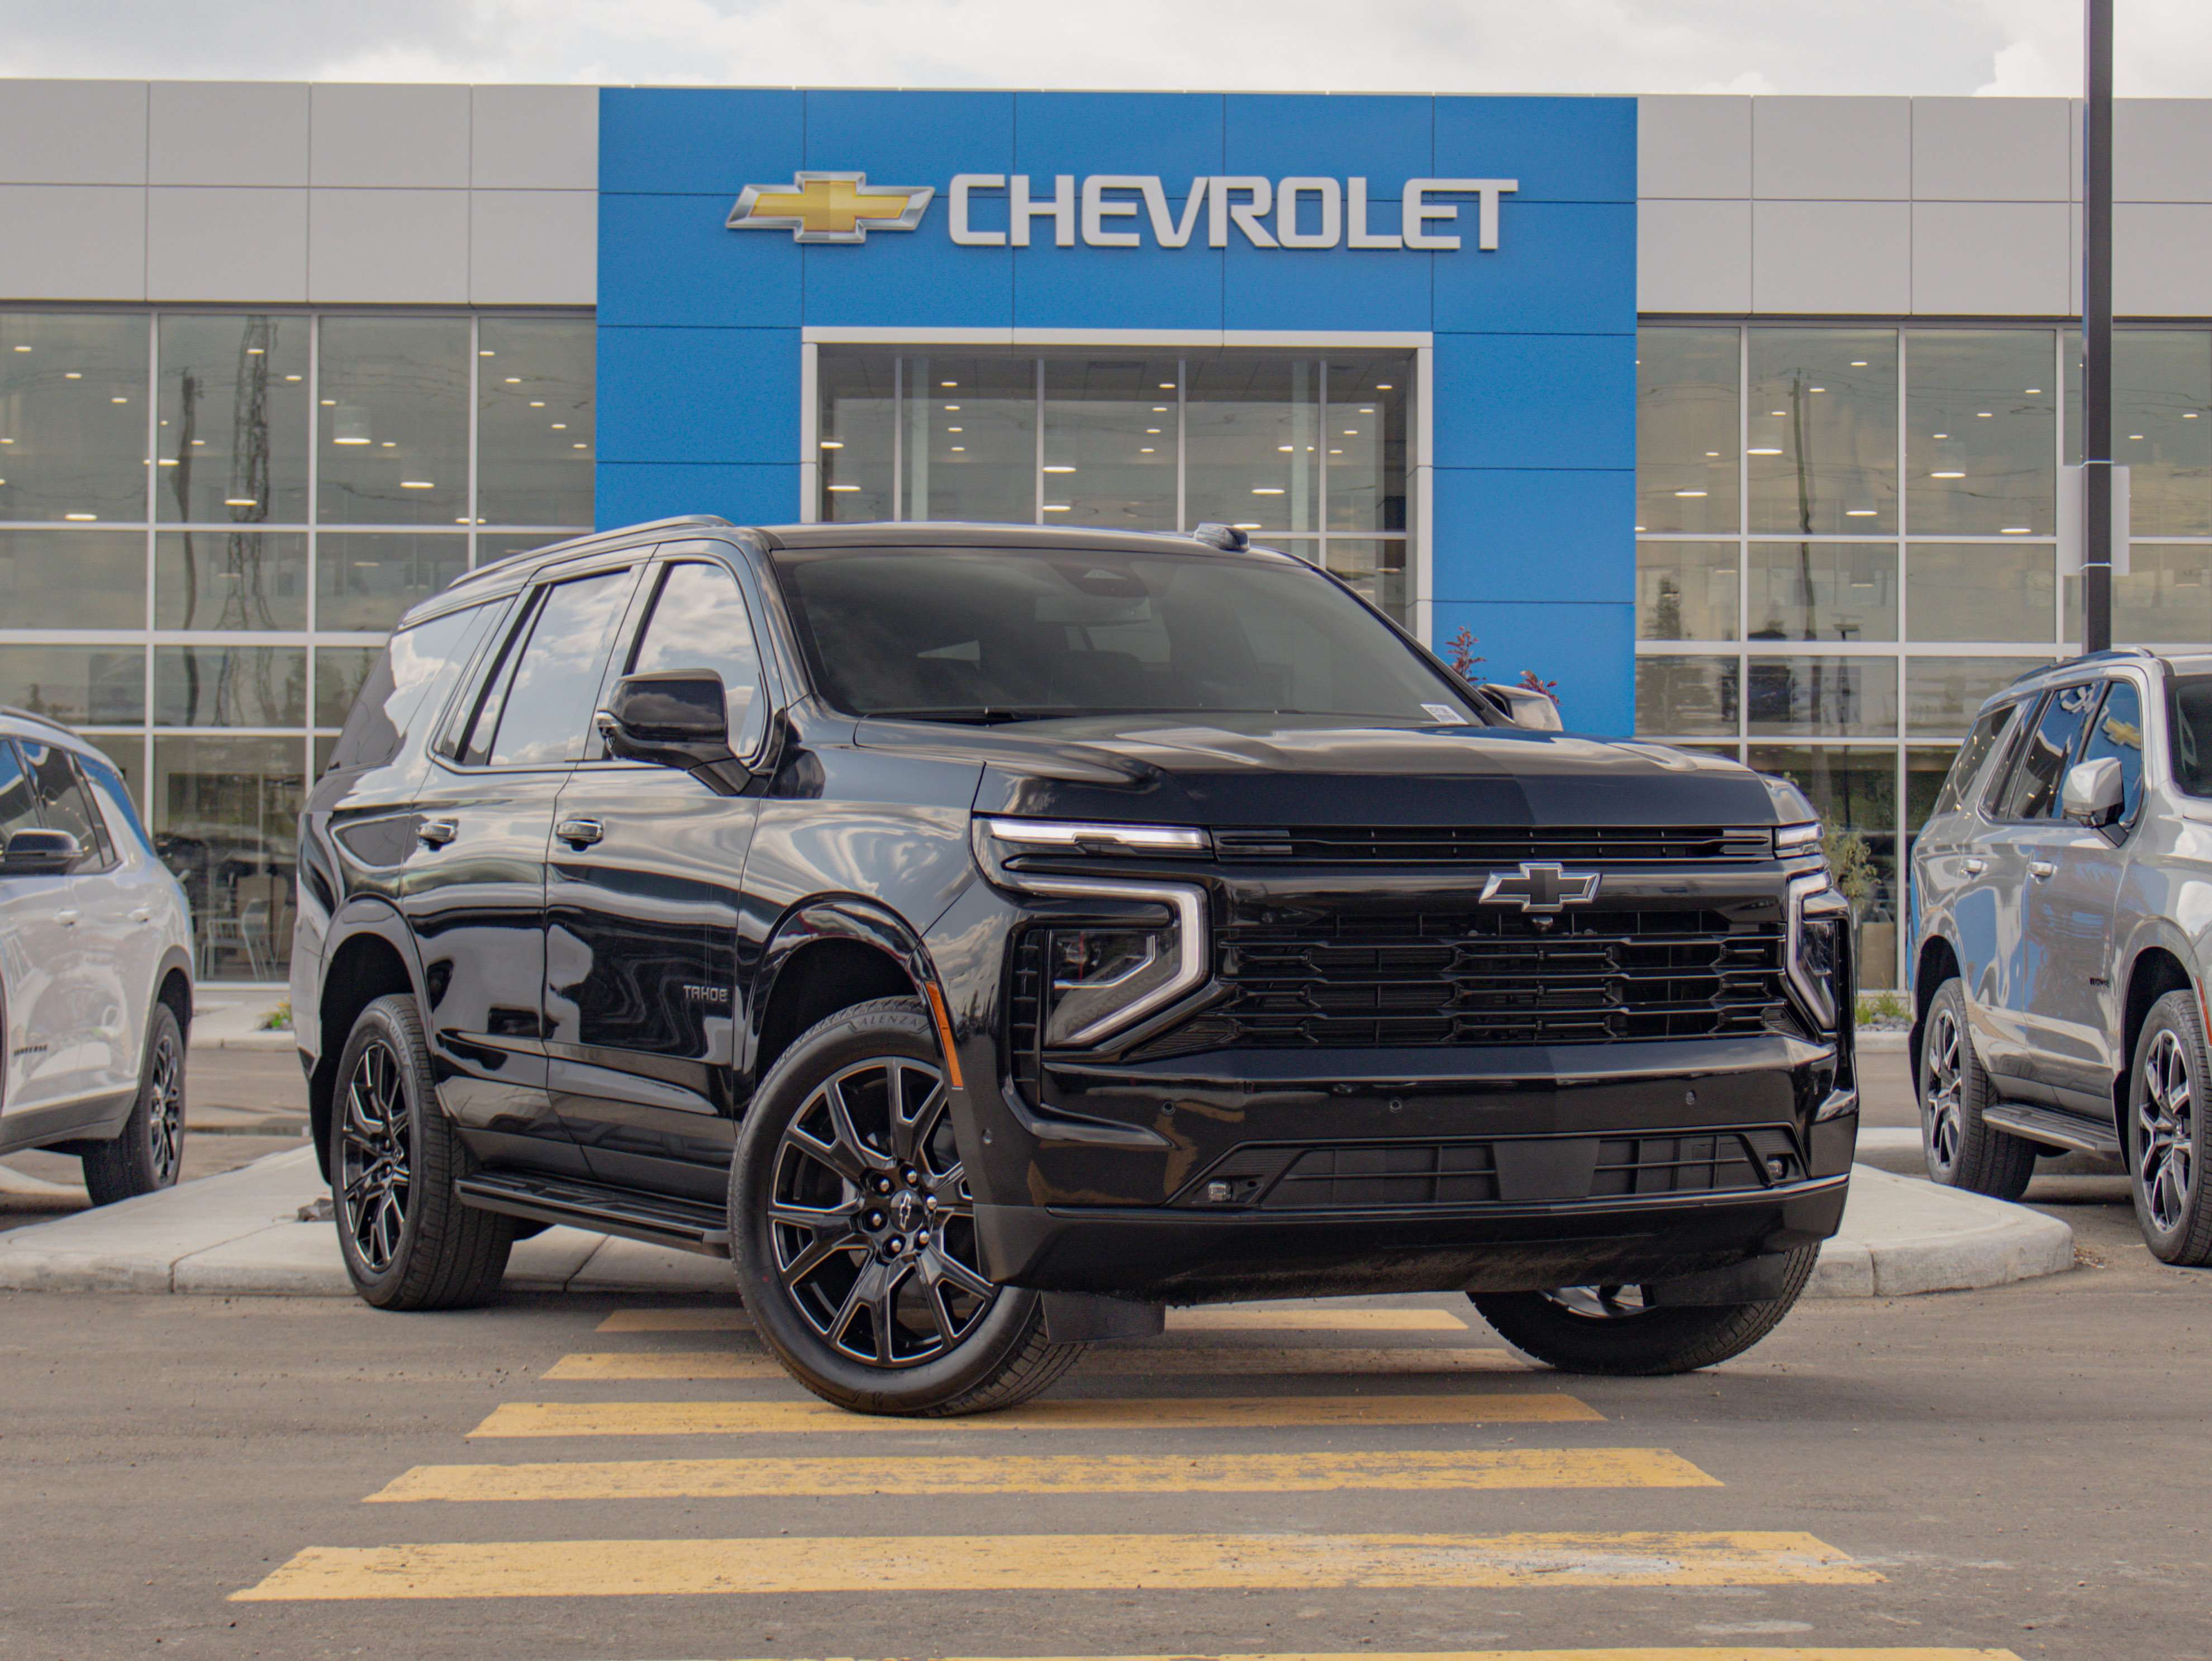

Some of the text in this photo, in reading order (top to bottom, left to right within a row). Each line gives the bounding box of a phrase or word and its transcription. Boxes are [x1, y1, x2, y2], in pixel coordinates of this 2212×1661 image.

[949, 174, 1518, 249] CHEVROLET
[683, 985, 728, 1002] TAHOE
[860, 1014, 917, 1027] ALENZA
